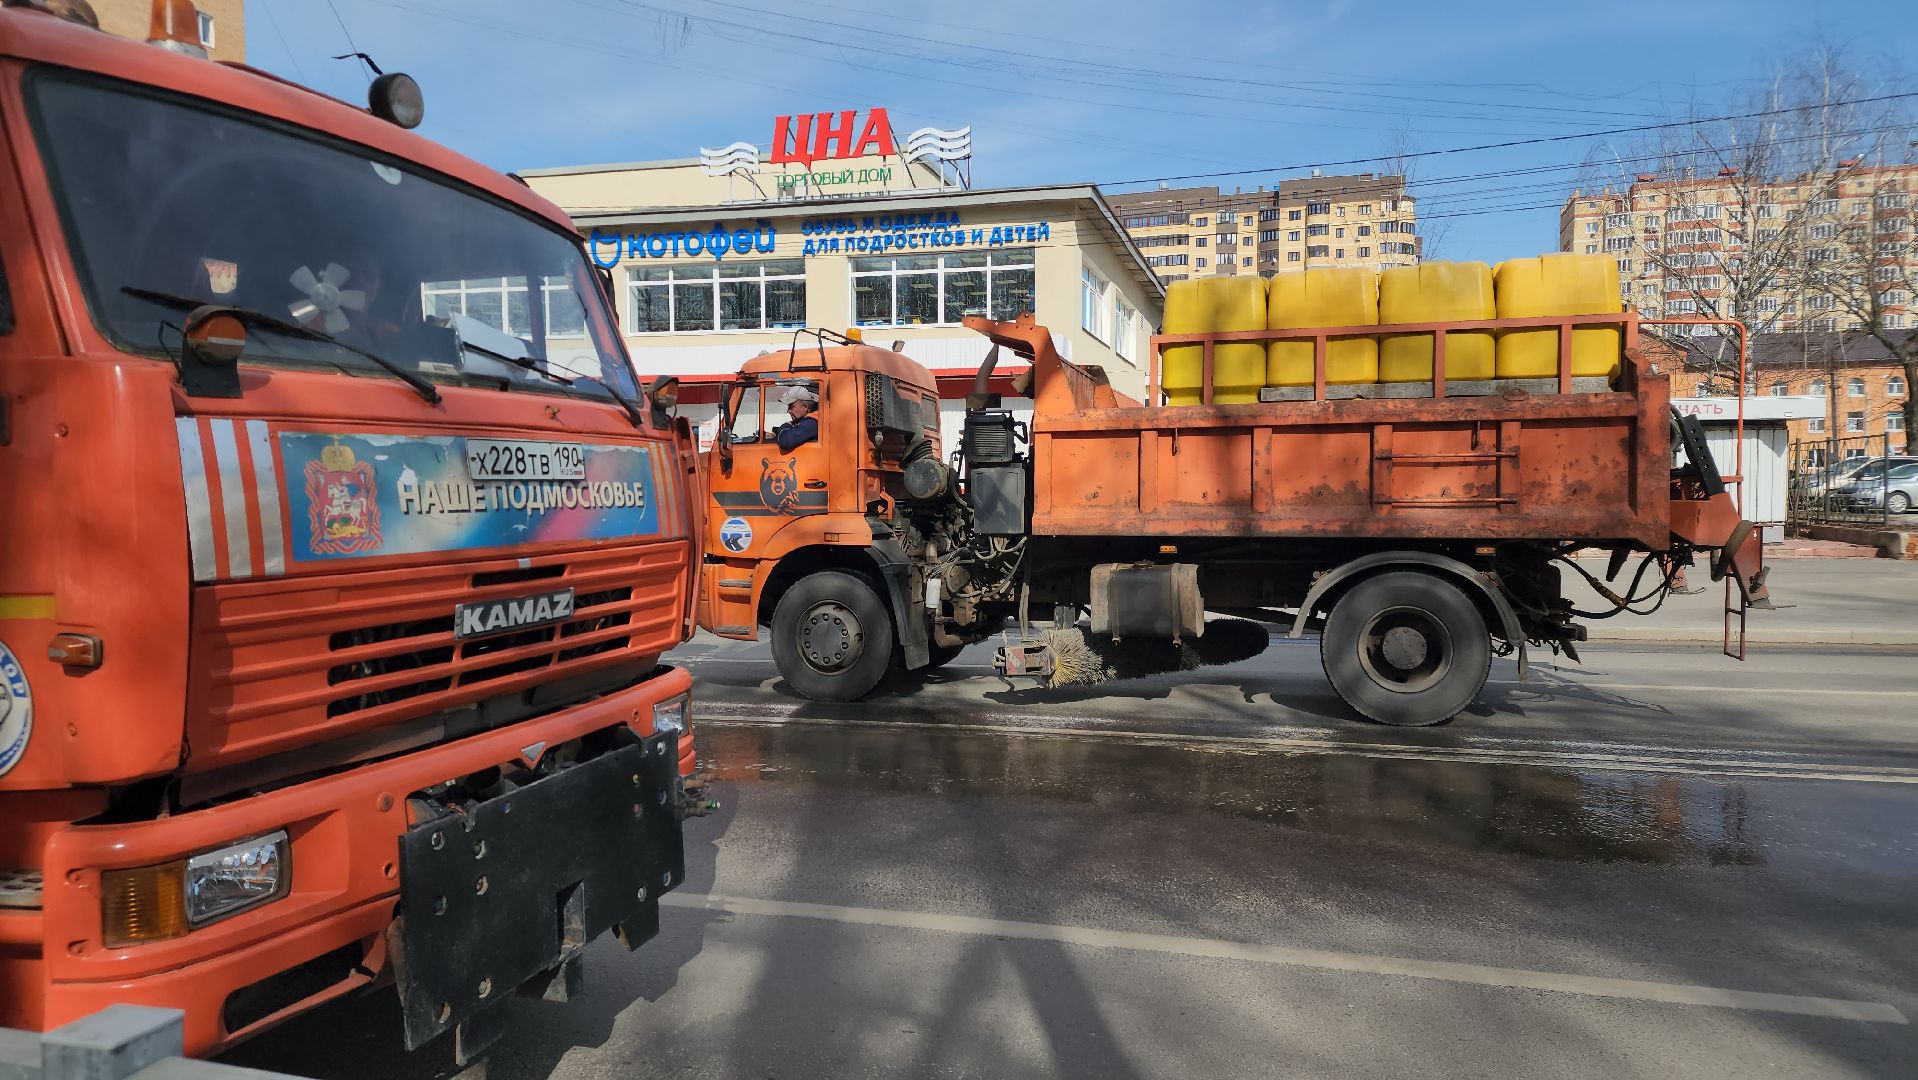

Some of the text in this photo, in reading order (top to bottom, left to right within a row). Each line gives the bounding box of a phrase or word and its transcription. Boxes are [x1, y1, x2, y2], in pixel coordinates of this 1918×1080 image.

[769, 107, 896, 173] ЦНА
[774, 167, 892, 188] ТОРГОВЫЙ ДОМ
[801, 211, 961, 236] ОБУВЬ И ОДЕЖДА
[802, 219, 1050, 257] ДЛЯ ПОДРОСТКОВ И ДЕТЕЙ
[1671, 403, 1723, 415] ЧАТЬ
[554, 446, 578, 467] 190
[397, 480, 645, 516] НАШЕ ПОДМОСКОВЬЕ
[463, 594, 571, 635] KAMAZ
